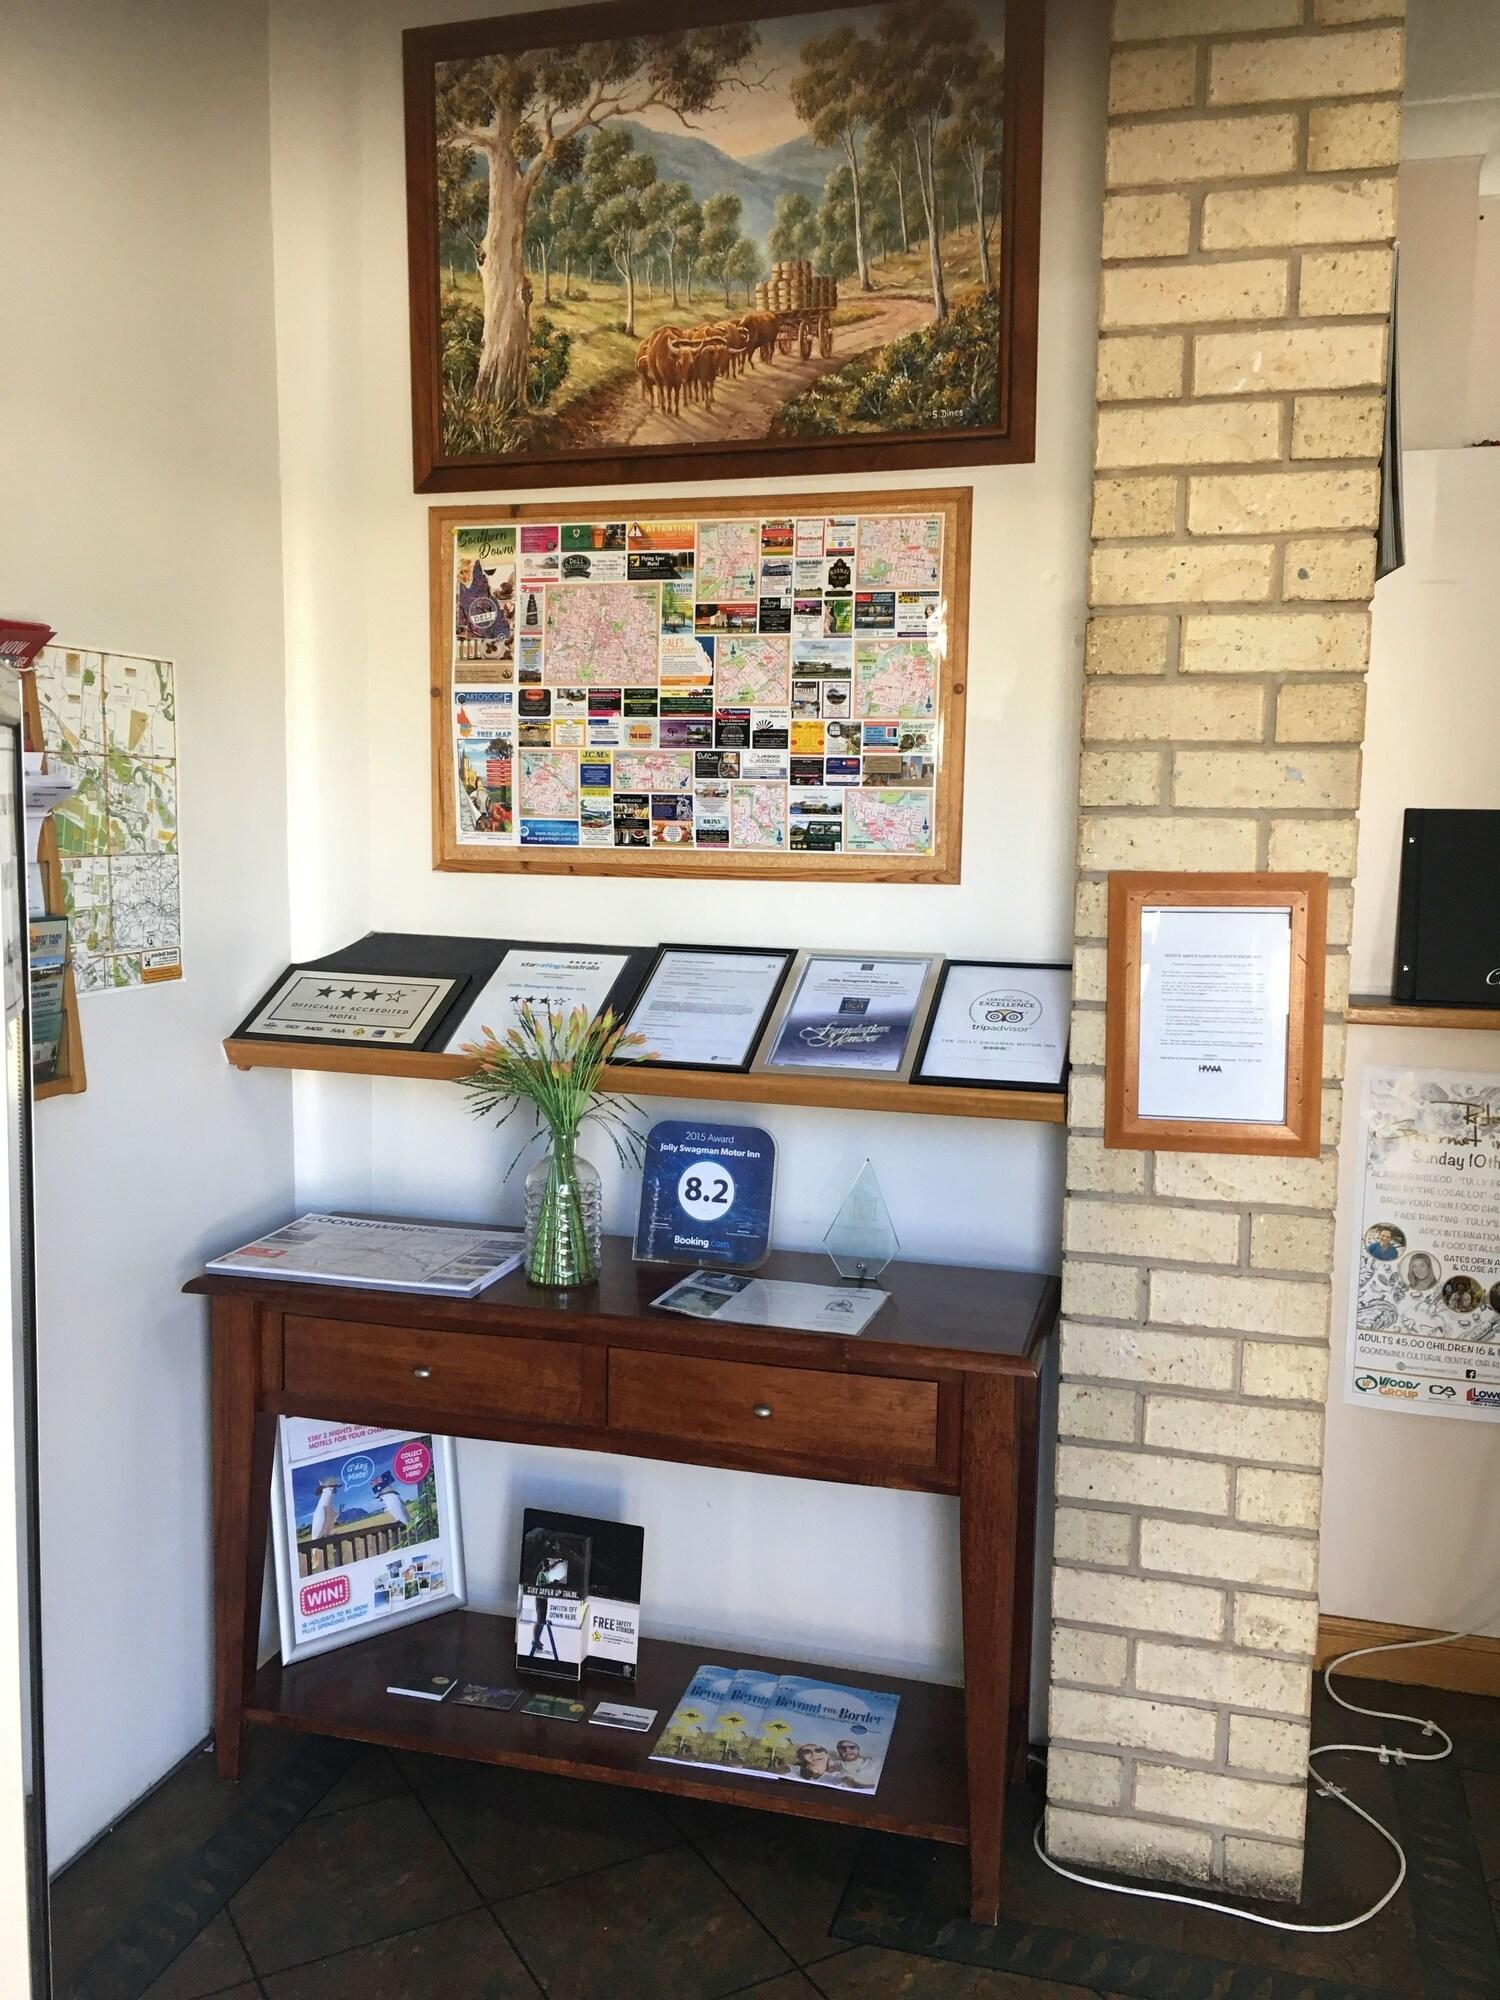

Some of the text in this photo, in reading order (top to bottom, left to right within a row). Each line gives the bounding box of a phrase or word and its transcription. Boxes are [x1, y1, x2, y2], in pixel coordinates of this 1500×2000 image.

[458, 529, 507, 547] Southern
[479, 543, 514, 559] Downs
[474, 613, 493, 623] DELI
[456, 692, 512, 705] CARTOSCOPE
[291, 1002, 410, 1016] OFFICIALLY ACCREDITED
[979, 1000, 1035, 1009] EXCELLENCE
[972, 1023, 1029, 1033] tripadvisor
[685, 1131, 735, 1144] 2015 Award
[660, 1142, 761, 1158] Jolly Swagman Motor Inn
[685, 1177, 729, 1204] 8.2
[1408, 1197, 1432, 1208] YOUR
[1433, 1199, 1453, 1210] OWN
[1454, 1200, 1480, 1212] FOOD
[1394, 1211, 1417, 1221] FACE
[1418, 1213, 1459, 1224] PAINTING
[1419, 1227, 1443, 1238] APEX
[1441, 1240, 1467, 1251] FOOD
[1443, 1254, 1470, 1264] GATES
[1471, 1256, 1494, 1266] OPEN
[1452, 1263, 1459, 1272] &
[1460, 1263, 1487, 1274] CLOSE
[1357, 1333, 1394, 1346] ADULTS
[1395, 1337, 1426, 1350] $5.00
[1426, 1342, 1475, 1354] CHILDREN
[1475, 1346, 1486, 1356] 16
[1406, 1351, 1442, 1363] CULTURAL
[1444, 1354, 1474, 1367] CENTRE
[1379, 1375, 1421, 1390] WOODS
[1378, 1386, 1419, 1400] GROUP
[307, 1434, 322, 1443] STAY
[328, 1427, 353, 1438] NIGHTS
[308, 1439, 333, 1450] MOTELS
[334, 1435, 347, 1444] FOR
[348, 1431, 366, 1441] YOUR
[401, 1448, 423, 1459] COLLECT
[346, 1461, 368, 1473] G'day
[404, 1456, 420, 1465] YOUR
[307, 1584, 344, 1608] WIN!
[308, 1613, 336, 1626] HOLIDAYS
[549, 1612, 564, 1620] DOWN
[593, 1615, 616, 1631] FREE
[775, 1695, 821, 1714] Beyond
[838, 1707, 884, 1726] Border
